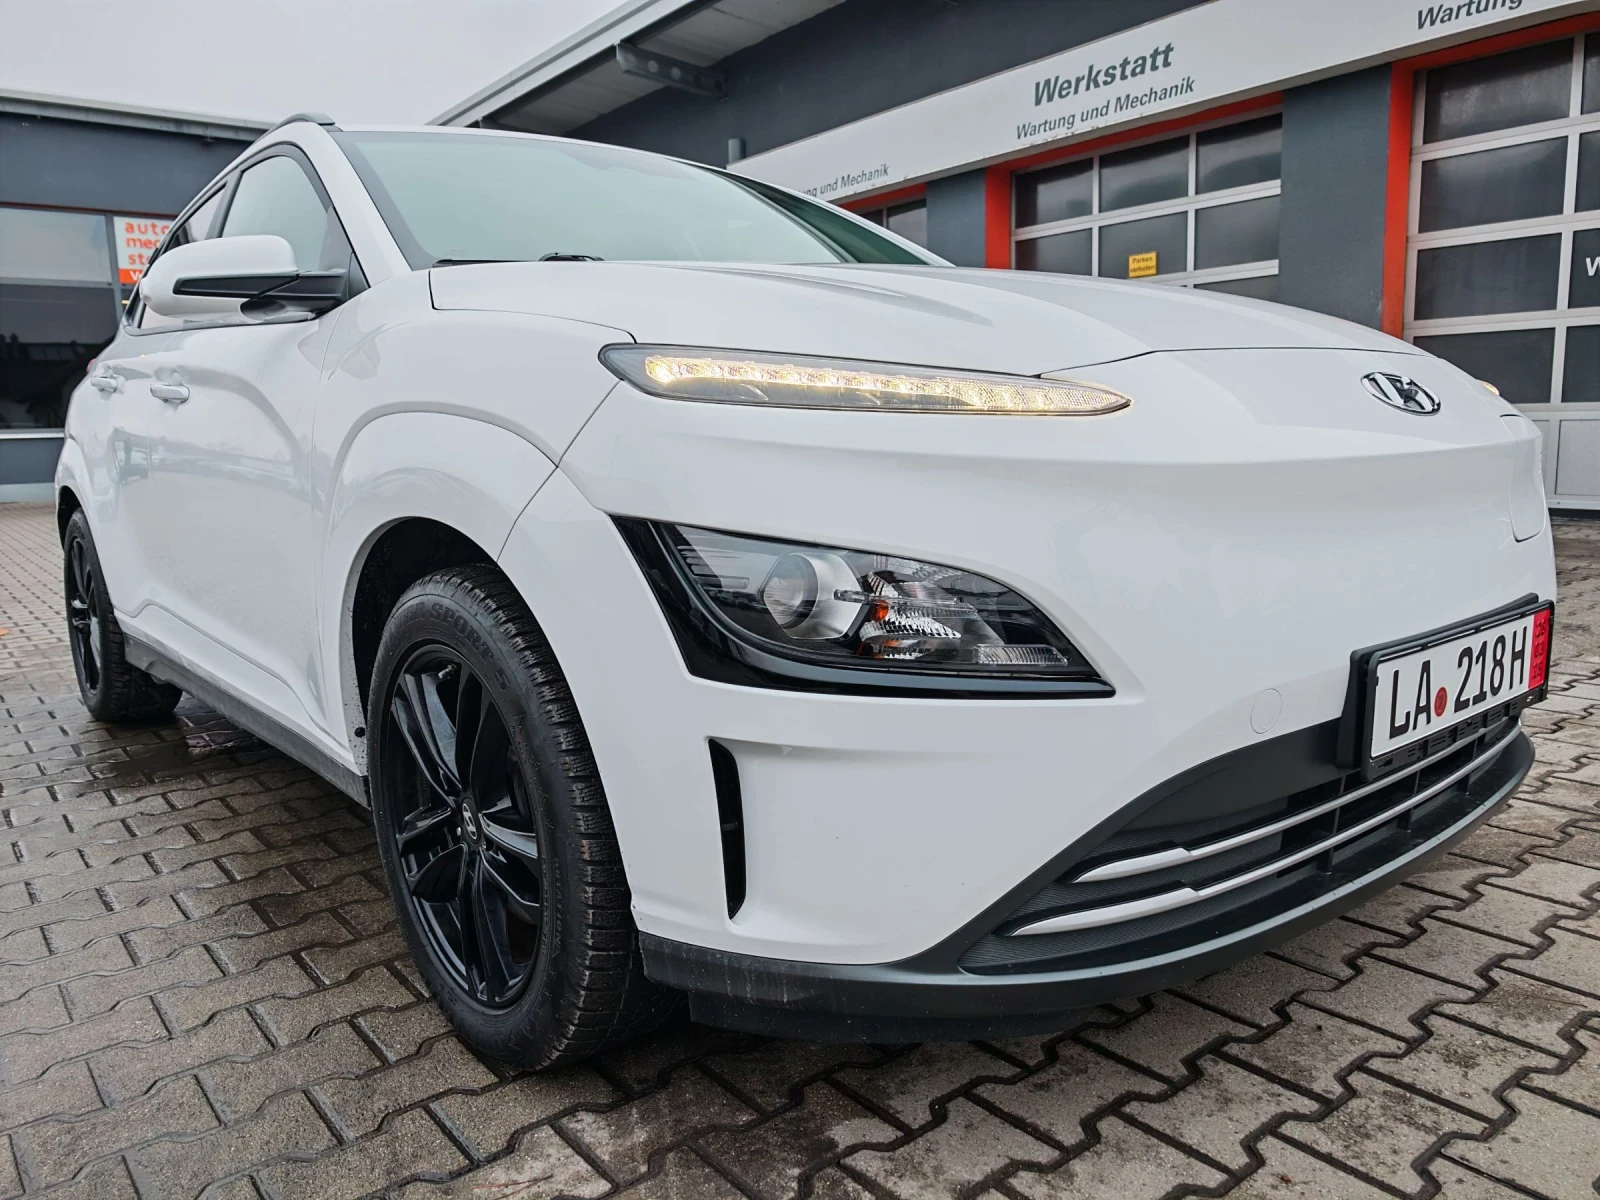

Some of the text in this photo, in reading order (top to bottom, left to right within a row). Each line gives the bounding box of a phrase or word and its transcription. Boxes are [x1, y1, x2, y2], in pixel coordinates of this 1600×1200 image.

[1034, 42, 1175, 107] Werkstatt
[1016, 75, 1196, 140] Wartung und Mechanik
[820, 177, 839, 195] und
[840, 163, 890, 189] Mechanik
[1388, 659, 1432, 740] LA
